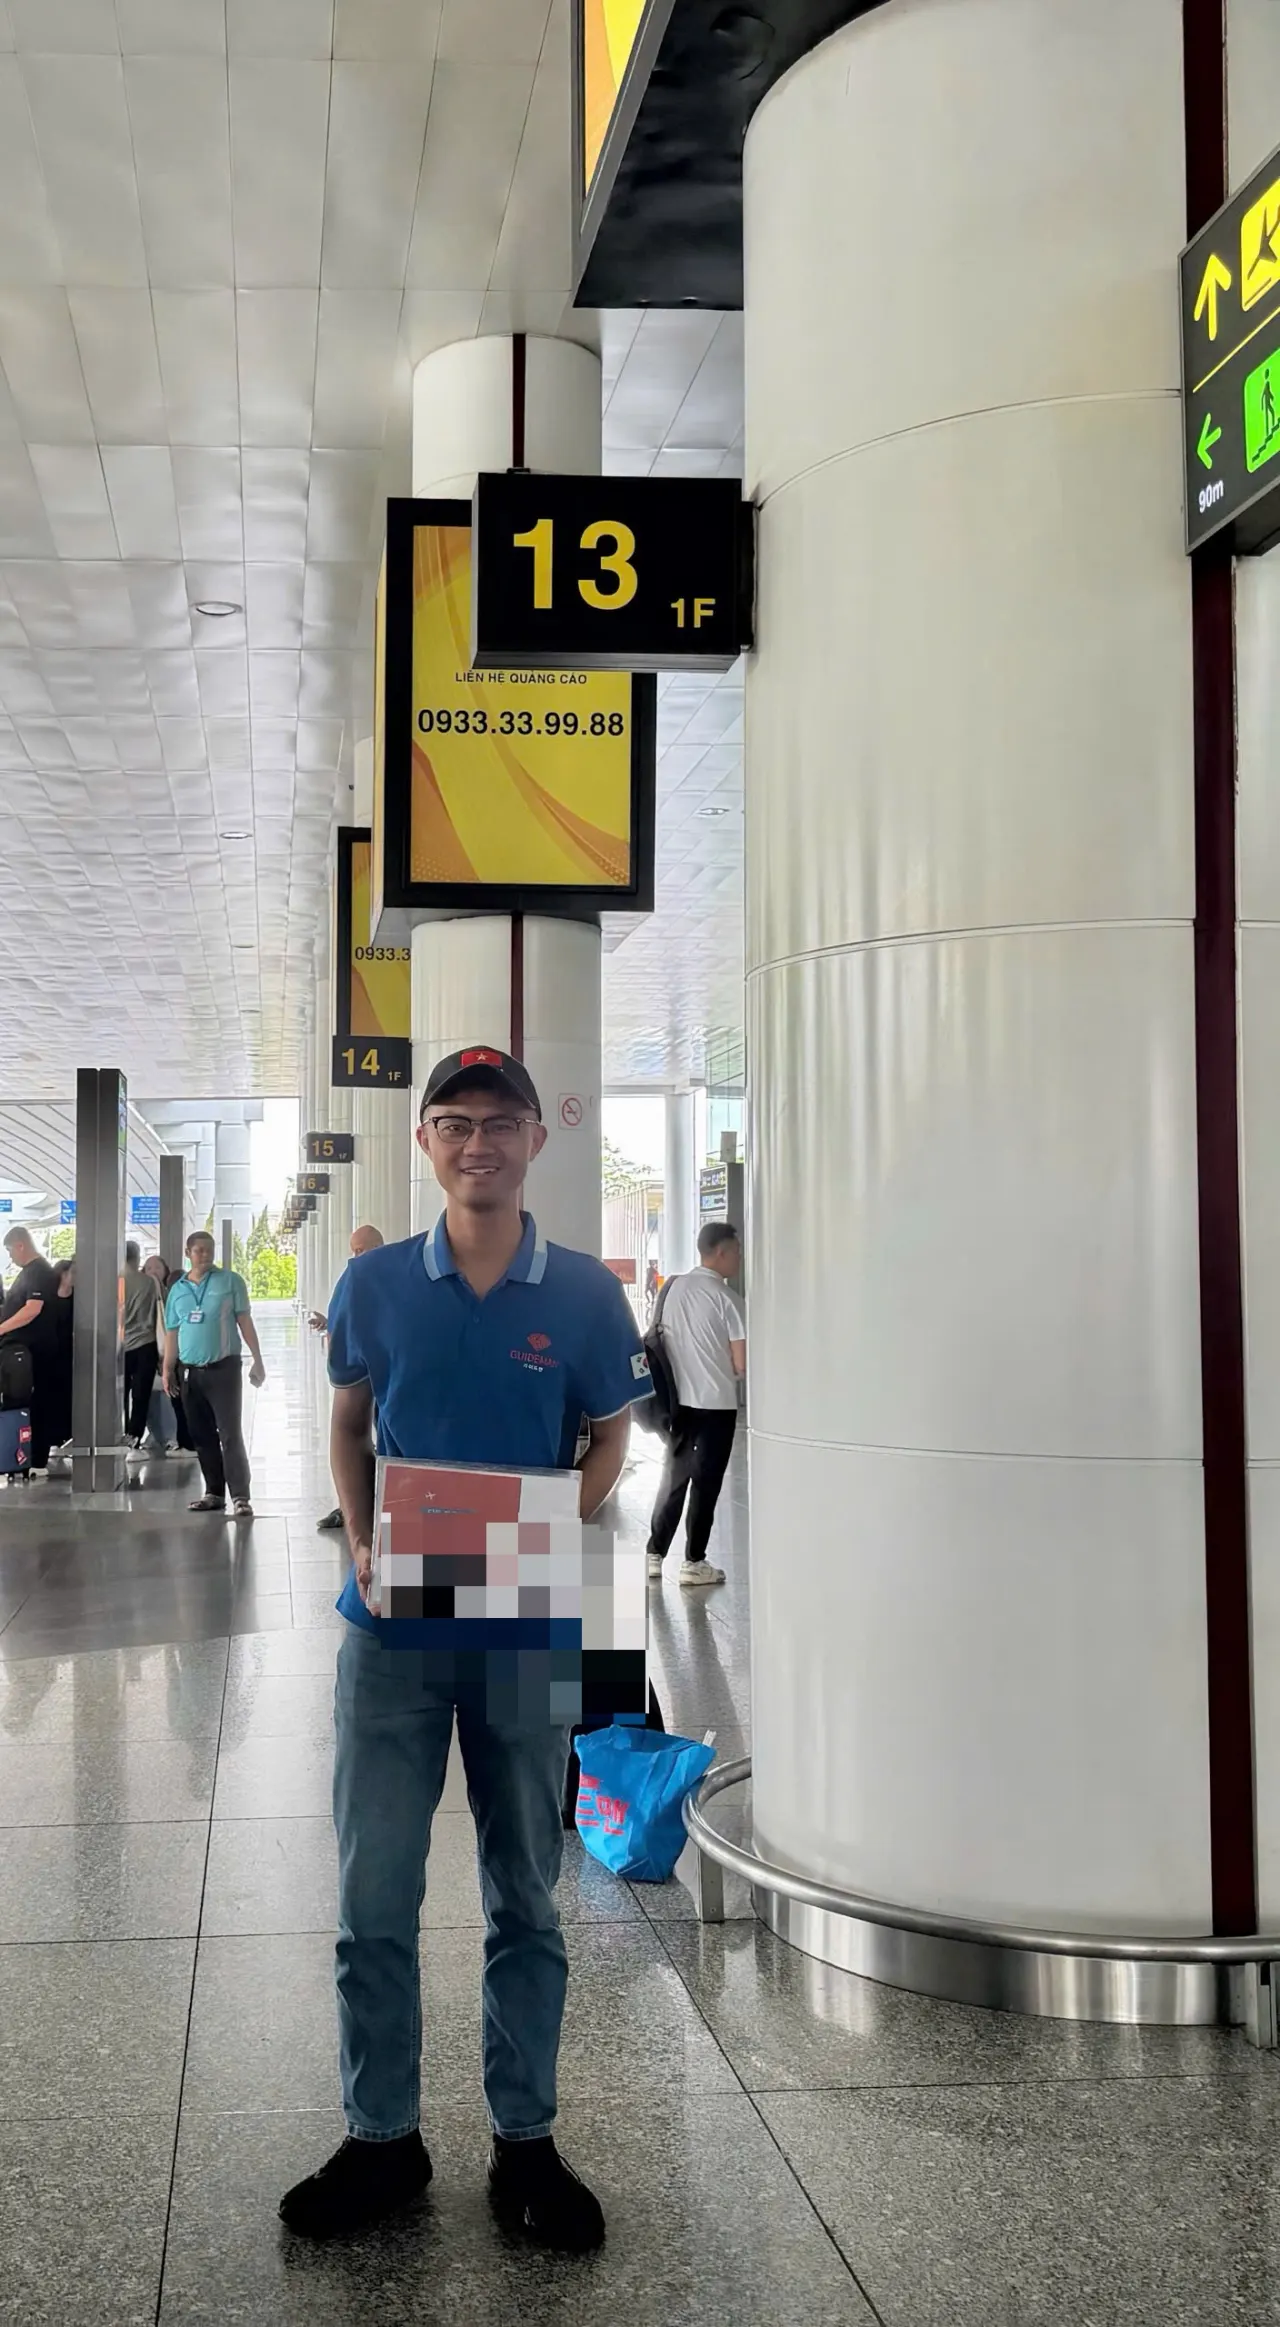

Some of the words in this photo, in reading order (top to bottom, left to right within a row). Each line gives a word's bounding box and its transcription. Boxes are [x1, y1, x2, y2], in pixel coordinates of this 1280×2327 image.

[1198, 479, 1225, 514] 90m
[513, 518, 639, 611] 13
[670, 597, 716, 629] 1F
[417, 708, 625, 737] 0933.33.99.88
[341, 1048, 380, 1076] 14
[387, 1070, 402, 1082] 1F
[312, 1140, 335, 1157] 15
[301, 1178, 316, 1190] 16
